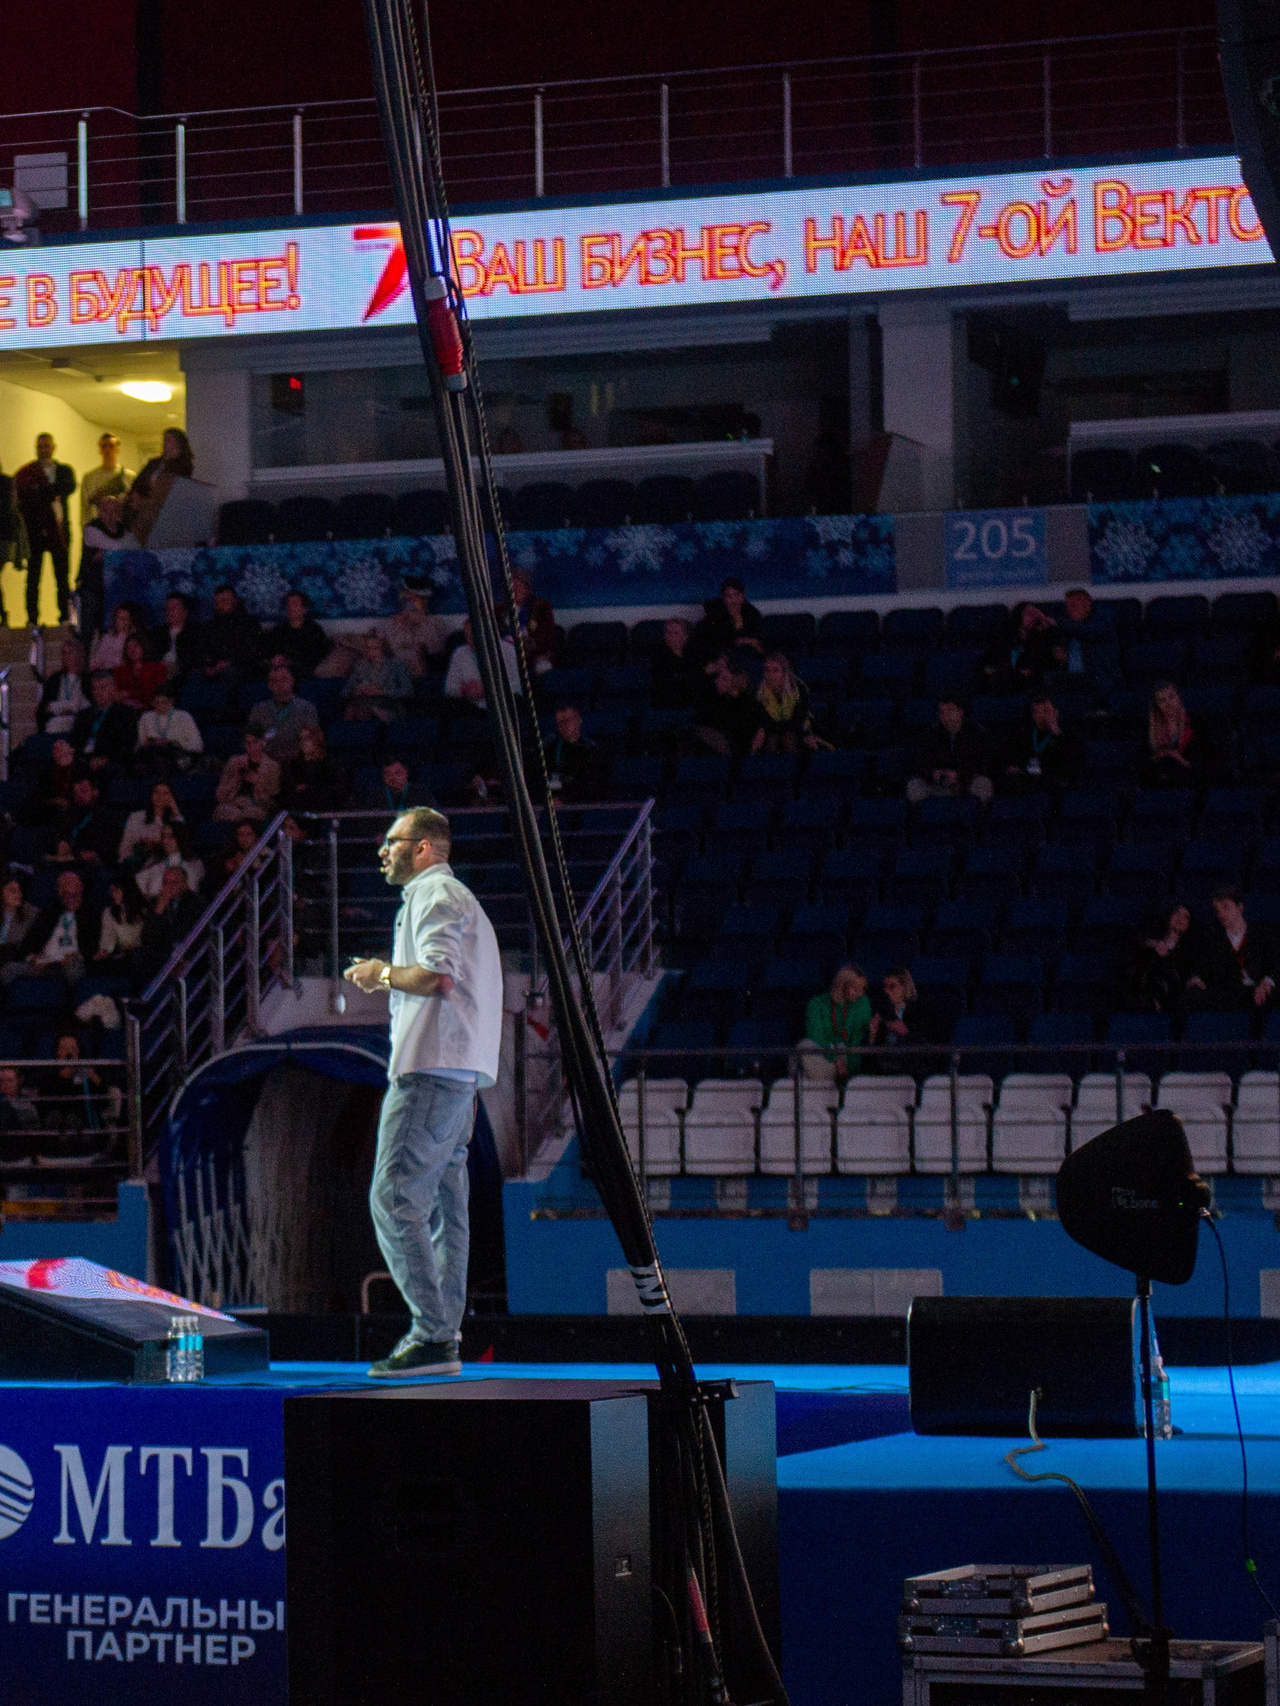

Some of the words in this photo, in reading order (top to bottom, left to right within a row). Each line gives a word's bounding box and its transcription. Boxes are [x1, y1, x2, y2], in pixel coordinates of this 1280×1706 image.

[580, 221, 786, 289] БИЗНЕС,
[803, 210, 928, 273] НАШ
[940, 178, 1079, 263] 7-ОЙ
[1093, 179, 1266, 253] ВЕКТО
[25, 274, 58, 328] В
[69, 241, 300, 334] БУДУЩЕЕ!
[952, 517, 1037, 560] 205
[53, 1444, 285, 1550] МТБа
[8, 1593, 284, 1631] ГЕНЕРАЛЬНЫ
[67, 1629, 256, 1666] ПАРТНЕР
